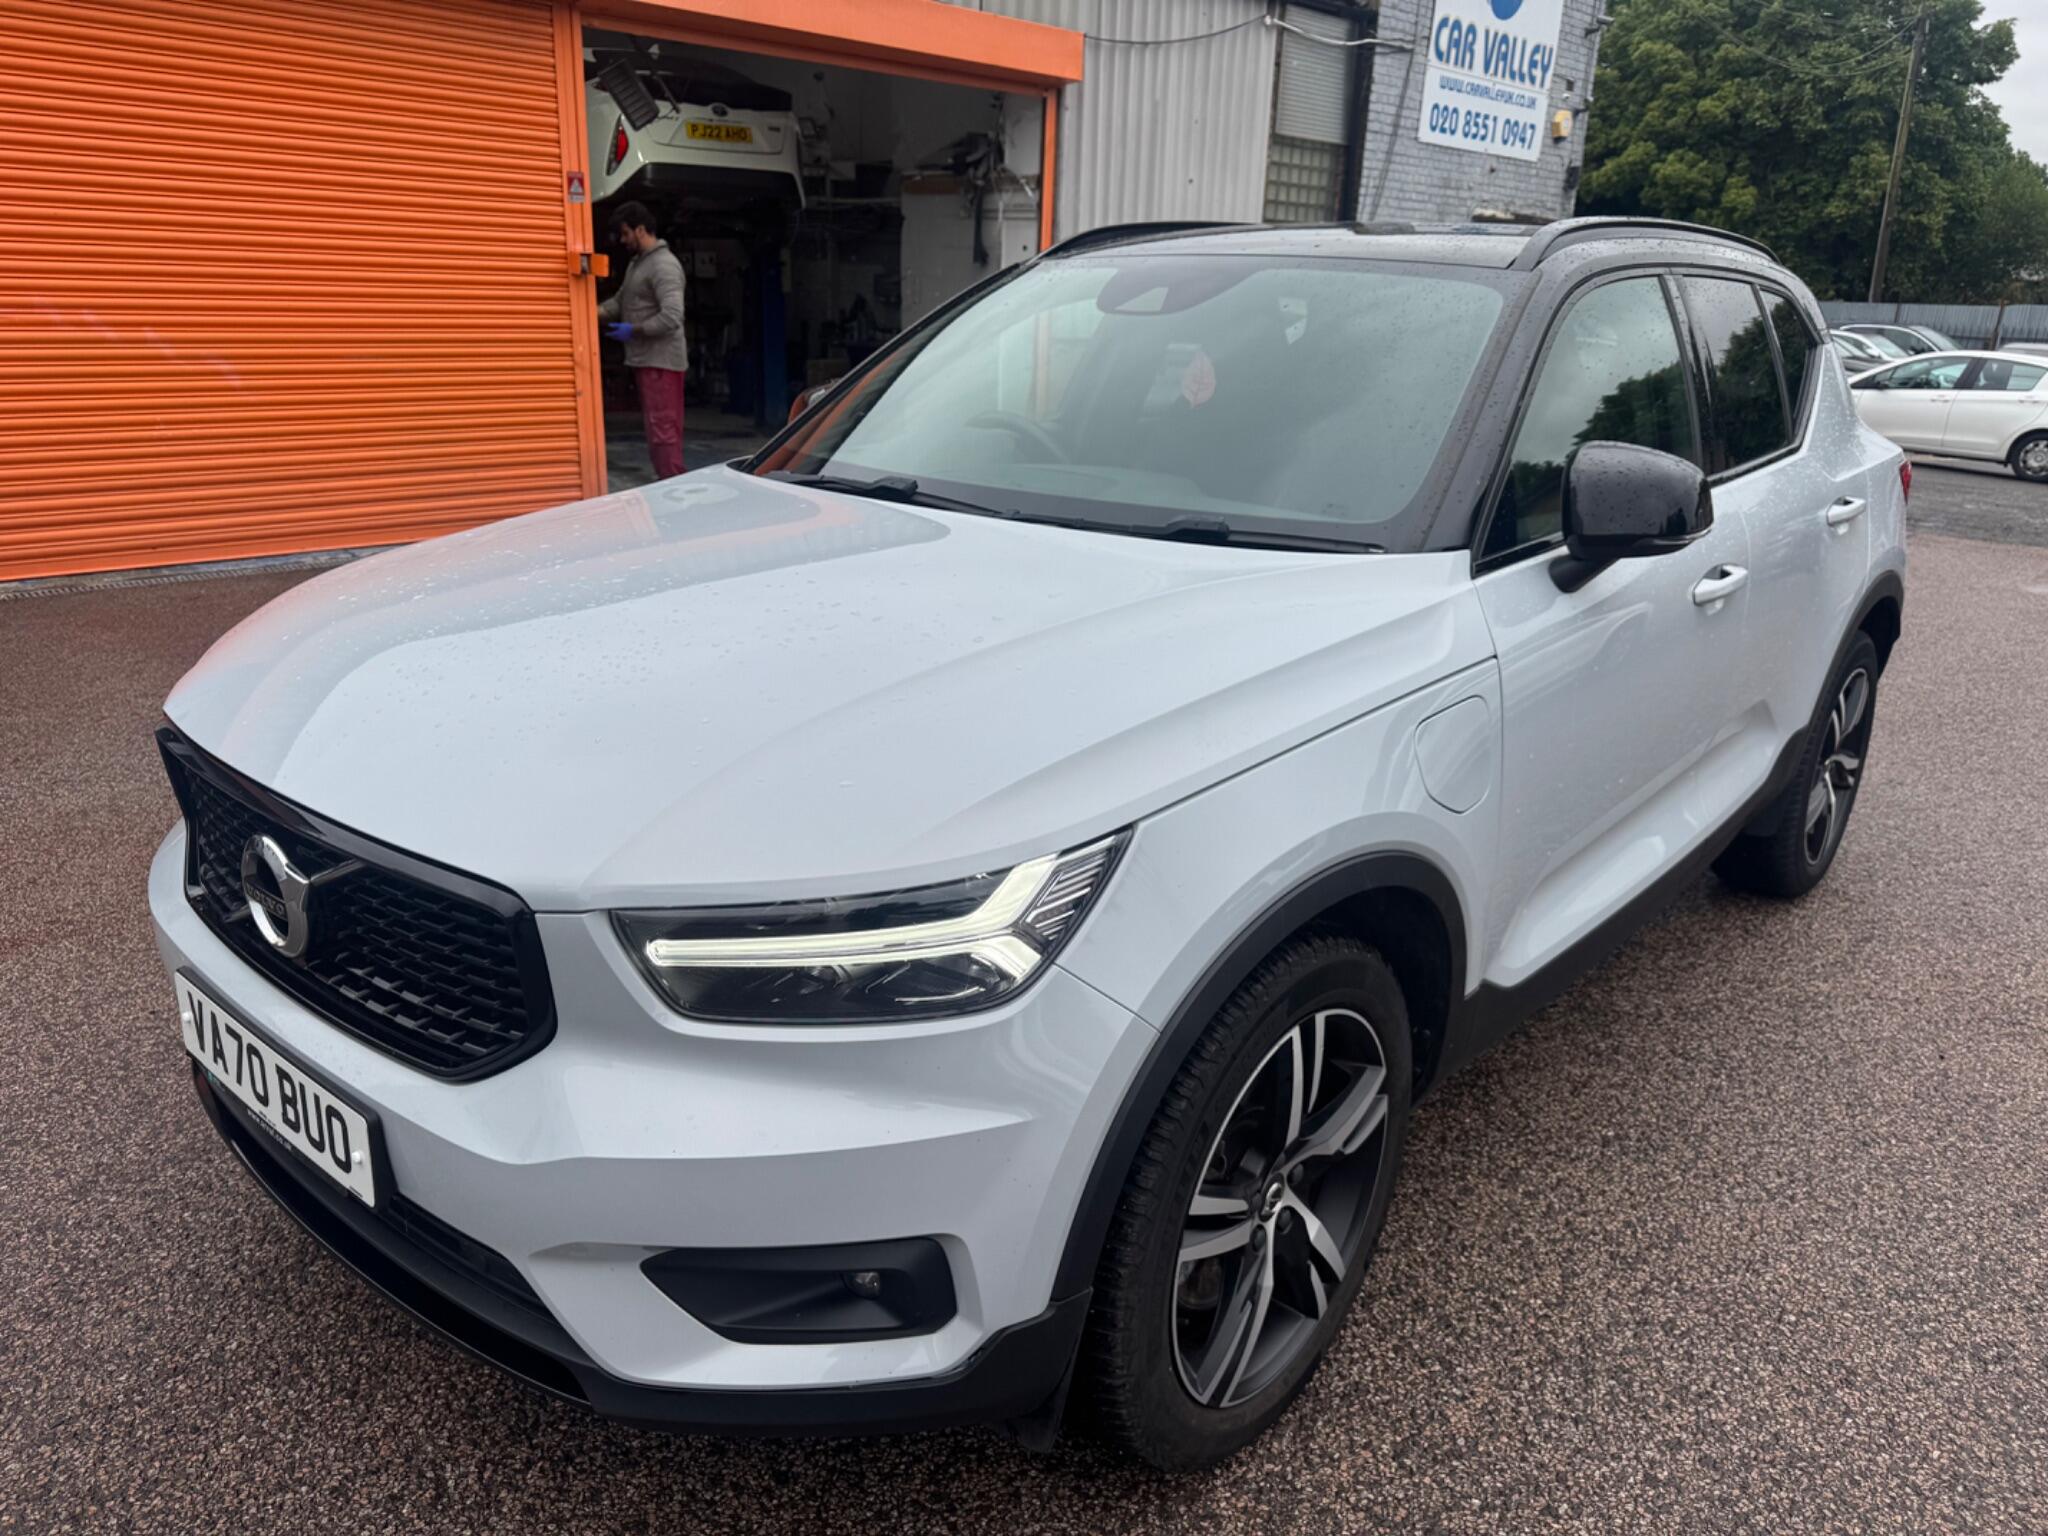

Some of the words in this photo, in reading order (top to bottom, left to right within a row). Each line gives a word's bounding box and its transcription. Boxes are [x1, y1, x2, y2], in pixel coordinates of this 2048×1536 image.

[1435, 16, 1477, 71] CAR
[1484, 28, 1553, 89] VALLEY
[1429, 103, 1459, 136] 020
[1462, 110, 1498, 143] 8551
[1502, 118, 1537, 151] 0947
[187, 990, 269, 1108] VA70
[275, 1063, 351, 1174] BUO
